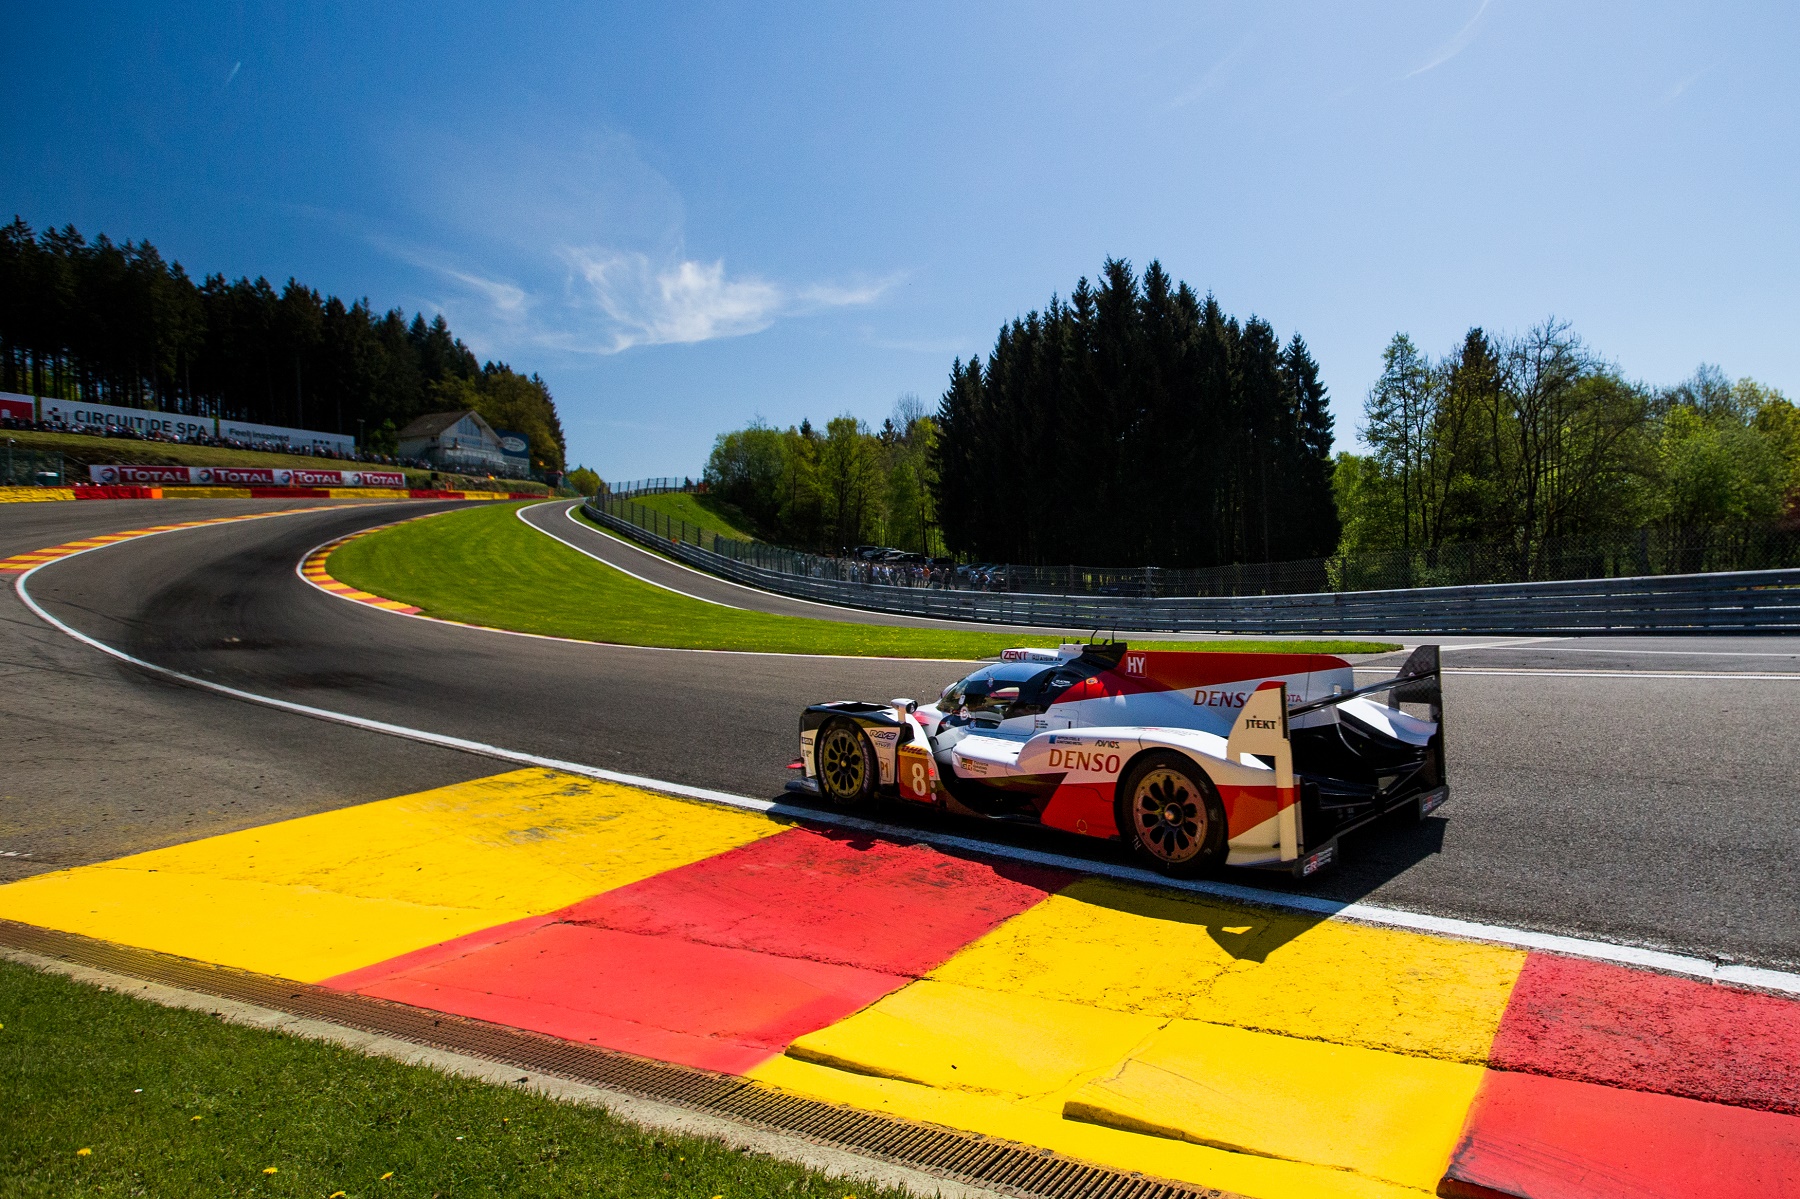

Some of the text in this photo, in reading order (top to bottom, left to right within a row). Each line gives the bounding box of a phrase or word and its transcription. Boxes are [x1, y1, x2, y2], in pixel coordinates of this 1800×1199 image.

[74, 410, 208, 436] CIRCUIT DE SPA
[121, 468, 188, 481] TOTAL
[215, 470, 271, 482] TOTAL
[295, 471, 341, 483] TOTAL
[363, 473, 402, 485] TOTAL
[1004, 651, 1029, 660] ZENT
[1127, 657, 1145, 673] HY
[1193, 690, 1252, 708] DENS
[1246, 719, 1276, 729] JTEKT
[870, 730, 896, 740] RAYS
[901, 745, 922, 755] DHL
[1049, 749, 1120, 774] DENSO
[912, 763, 926, 796] 8
